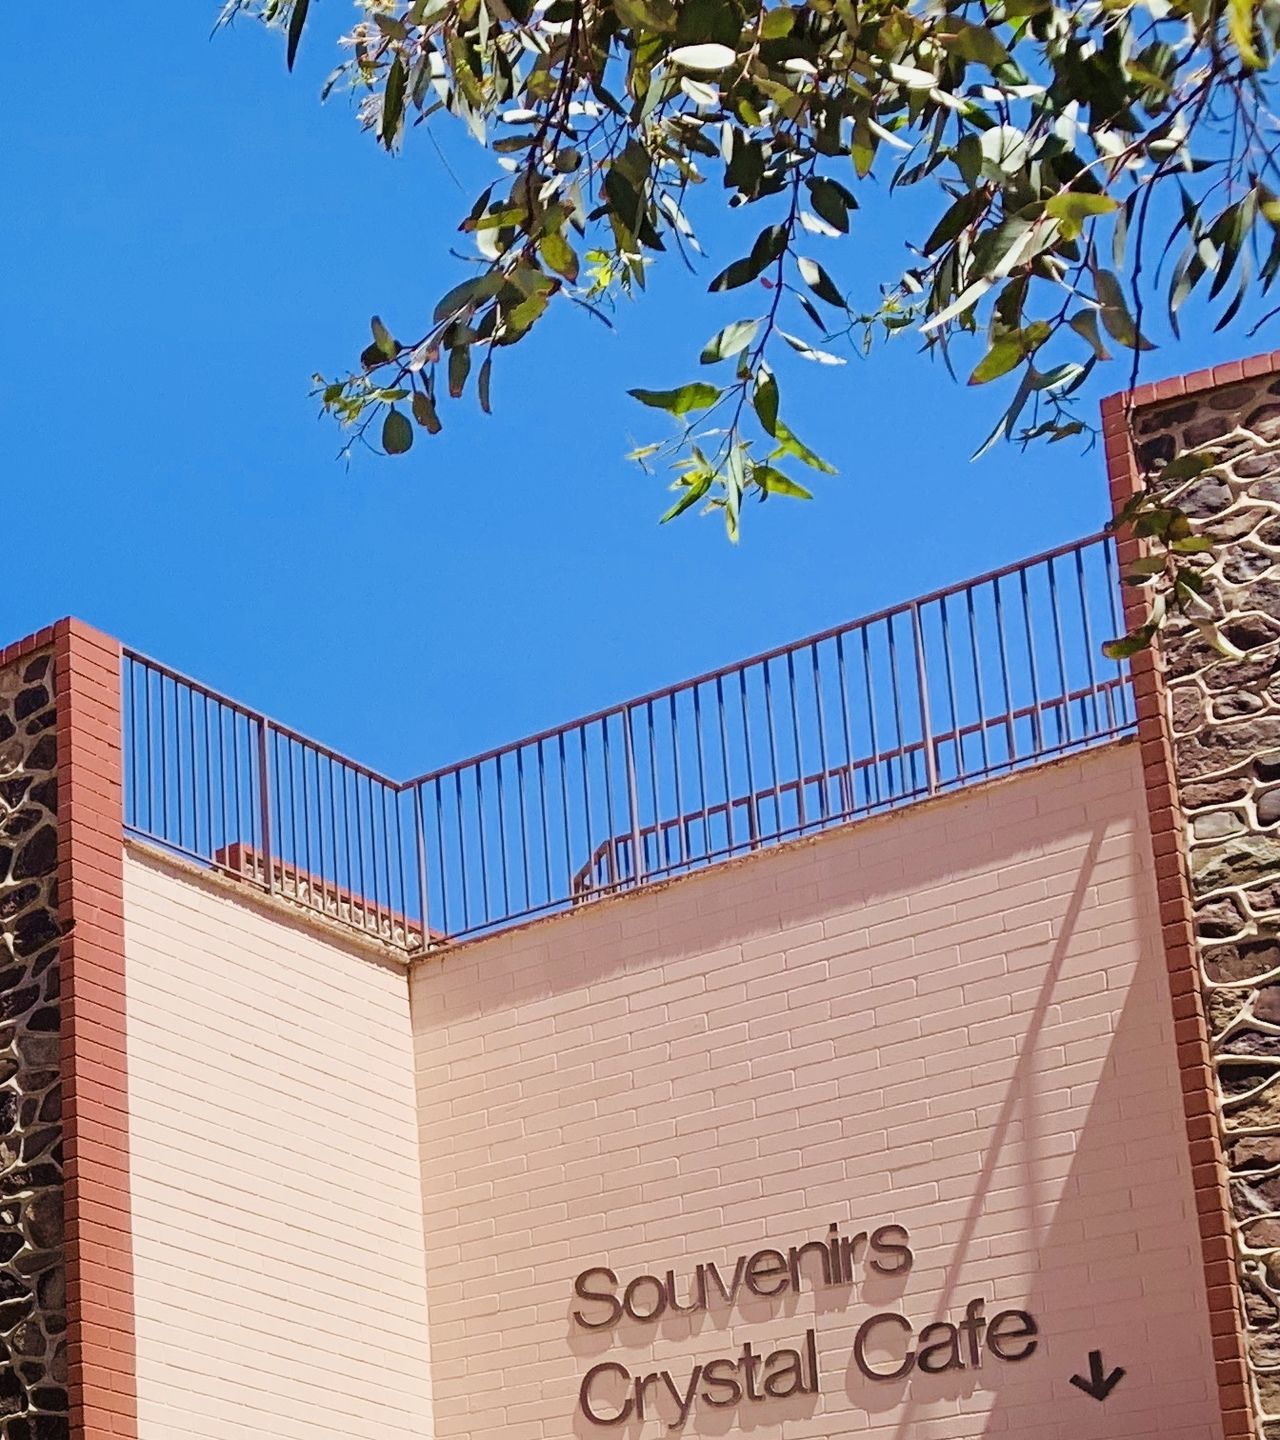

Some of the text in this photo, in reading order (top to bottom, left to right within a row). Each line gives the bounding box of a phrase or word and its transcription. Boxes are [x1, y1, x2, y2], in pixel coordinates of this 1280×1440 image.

[572, 1222, 914, 1330] Souvenirs
[579, 1297, 1039, 1430] Crystal Cafe
